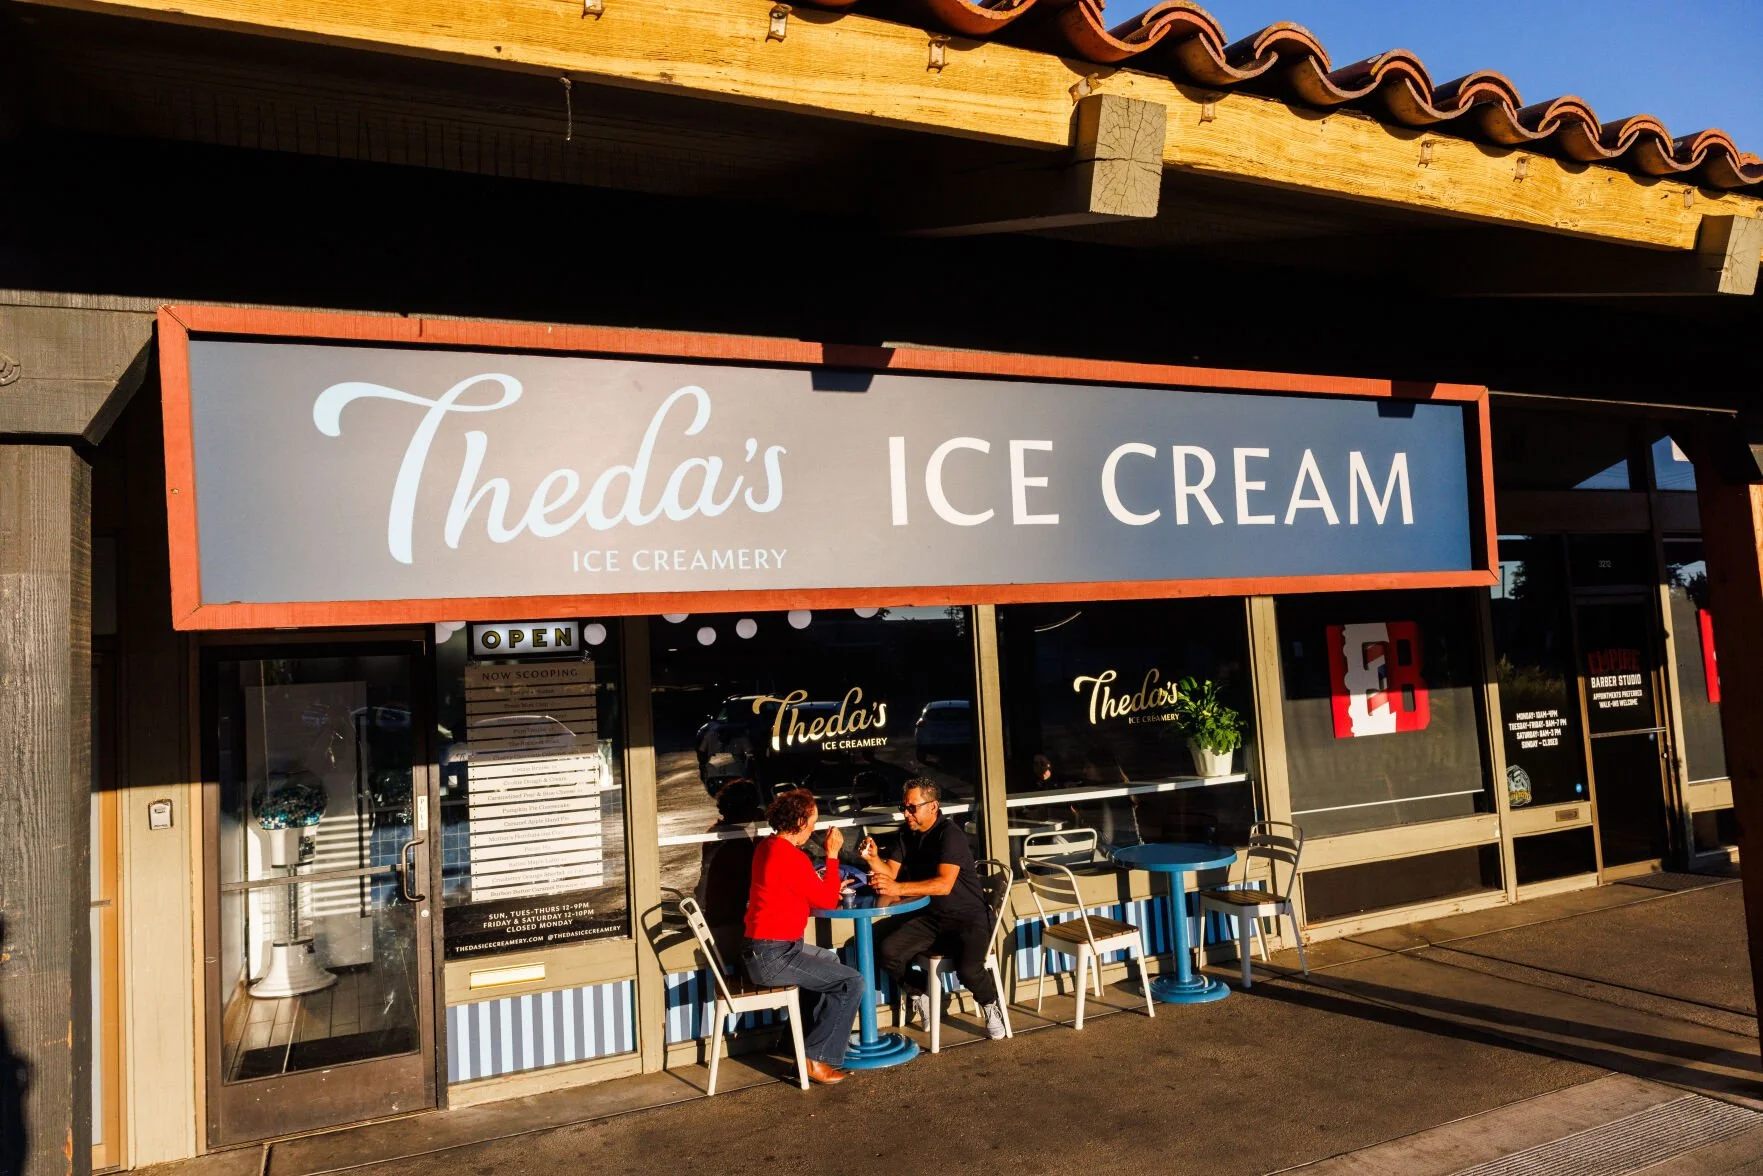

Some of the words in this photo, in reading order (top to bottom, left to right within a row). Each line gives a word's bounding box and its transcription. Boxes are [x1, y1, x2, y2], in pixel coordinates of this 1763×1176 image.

[312, 372, 788, 565] Theda's
[888, 436, 1060, 527] ICE
[1101, 441, 1415, 527] CREAM
[574, 550, 619, 573] ICE
[632, 548, 788, 572] CREAMERY
[481, 627, 572, 650] OPEN
[482, 671, 511, 681] NOW
[516, 668, 579, 679] SCOOPING
[1591, 676, 1617, 689] BARBER
[1618, 673, 1642, 687] STUDIO
[1073, 668, 1179, 725] Theda's
[752, 687, 887, 752] Theda's
[1142, 714, 1180, 723] CREAMERY
[822, 741, 837, 751] ICE
[839, 737, 888, 750] CREAMERY
[483, 919, 512, 929] FRIDAY
[522, 913, 562, 924] SATURDAY
[564, 908, 595, 919] 12-10PM
[510, 905, 561, 917] TUES-THURS
[562, 902, 590, 912] 12-9PM
[506, 924, 537, 933] CLOSED
[539, 919, 574, 929] MONDAY
[455, 935, 544, 952] THEDASICECREAMERY.COM
[547, 925, 622, 942] @THEDASICECREAMERY
